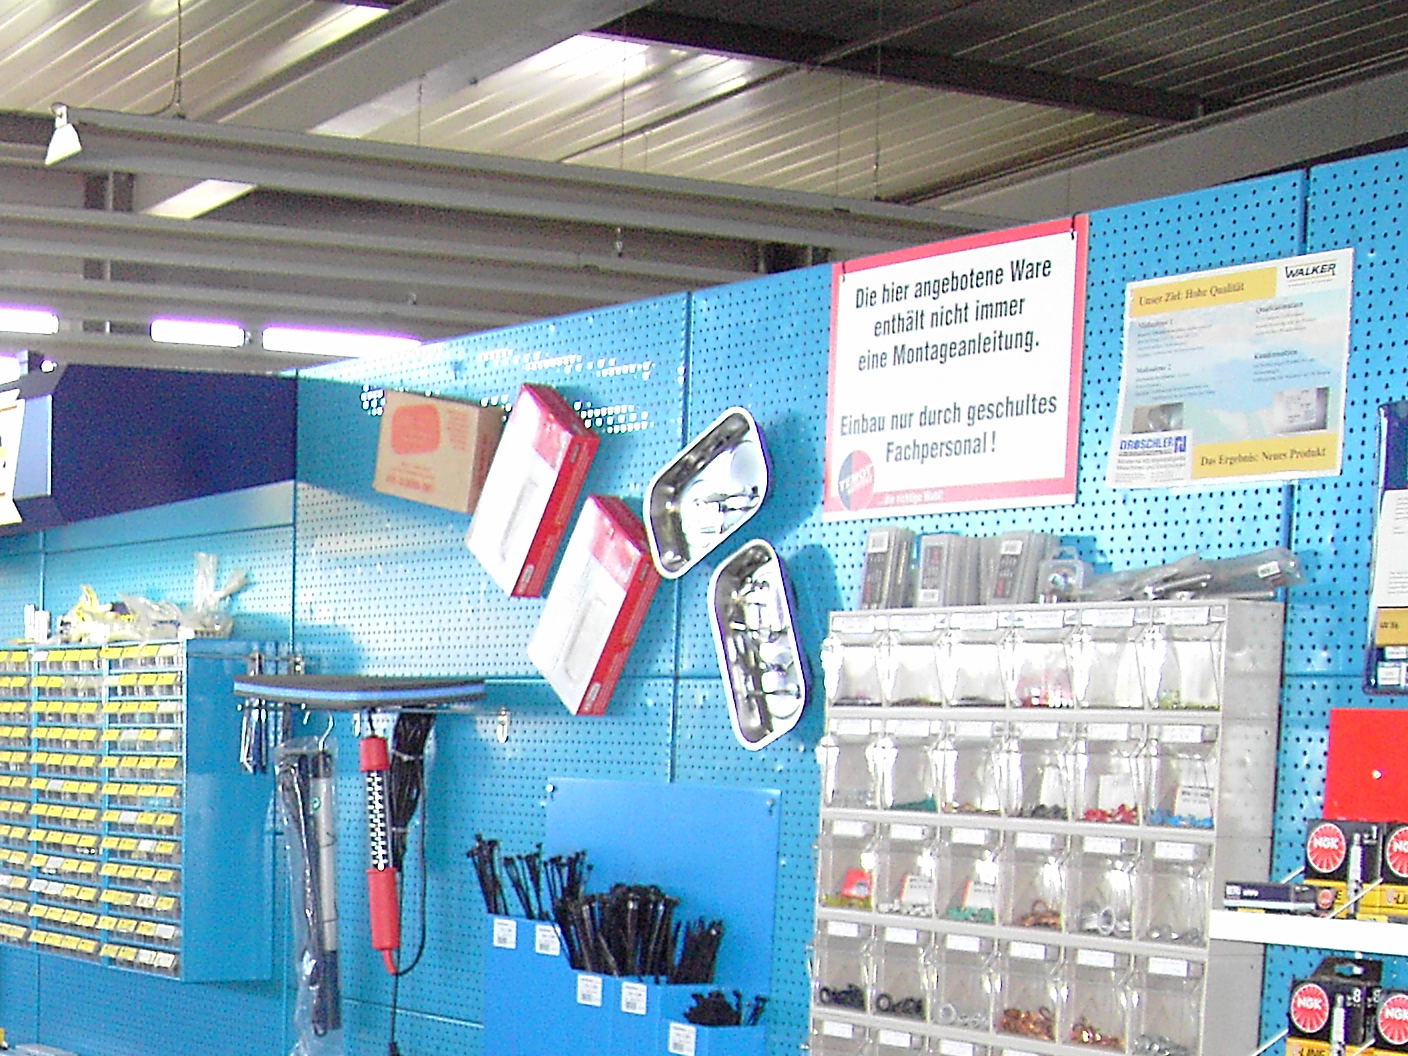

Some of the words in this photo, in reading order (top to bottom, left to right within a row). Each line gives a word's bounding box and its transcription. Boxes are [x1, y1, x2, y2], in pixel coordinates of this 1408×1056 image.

[856, 287, 877, 309] Die
[882, 281, 910, 305] hier
[914, 267, 1004, 301] angebotene
[1010, 259, 1052, 281] Ware
[1285, 263, 1337, 280] WALKER
[874, 309, 925, 337] enthält
[931, 302, 969, 328] nicht
[975, 297, 1025, 322] immer
[858, 350, 888, 371] eine
[893, 329, 1040, 364] Montageanleitung.
[840, 412, 886, 436] Einbau
[891, 411, 914, 430] nur
[919, 402, 961, 427] durch
[967, 394, 1058, 427] geschultes
[1313, 836, 1340, 850] NGK
[1296, 997, 1323, 1010] NGK
